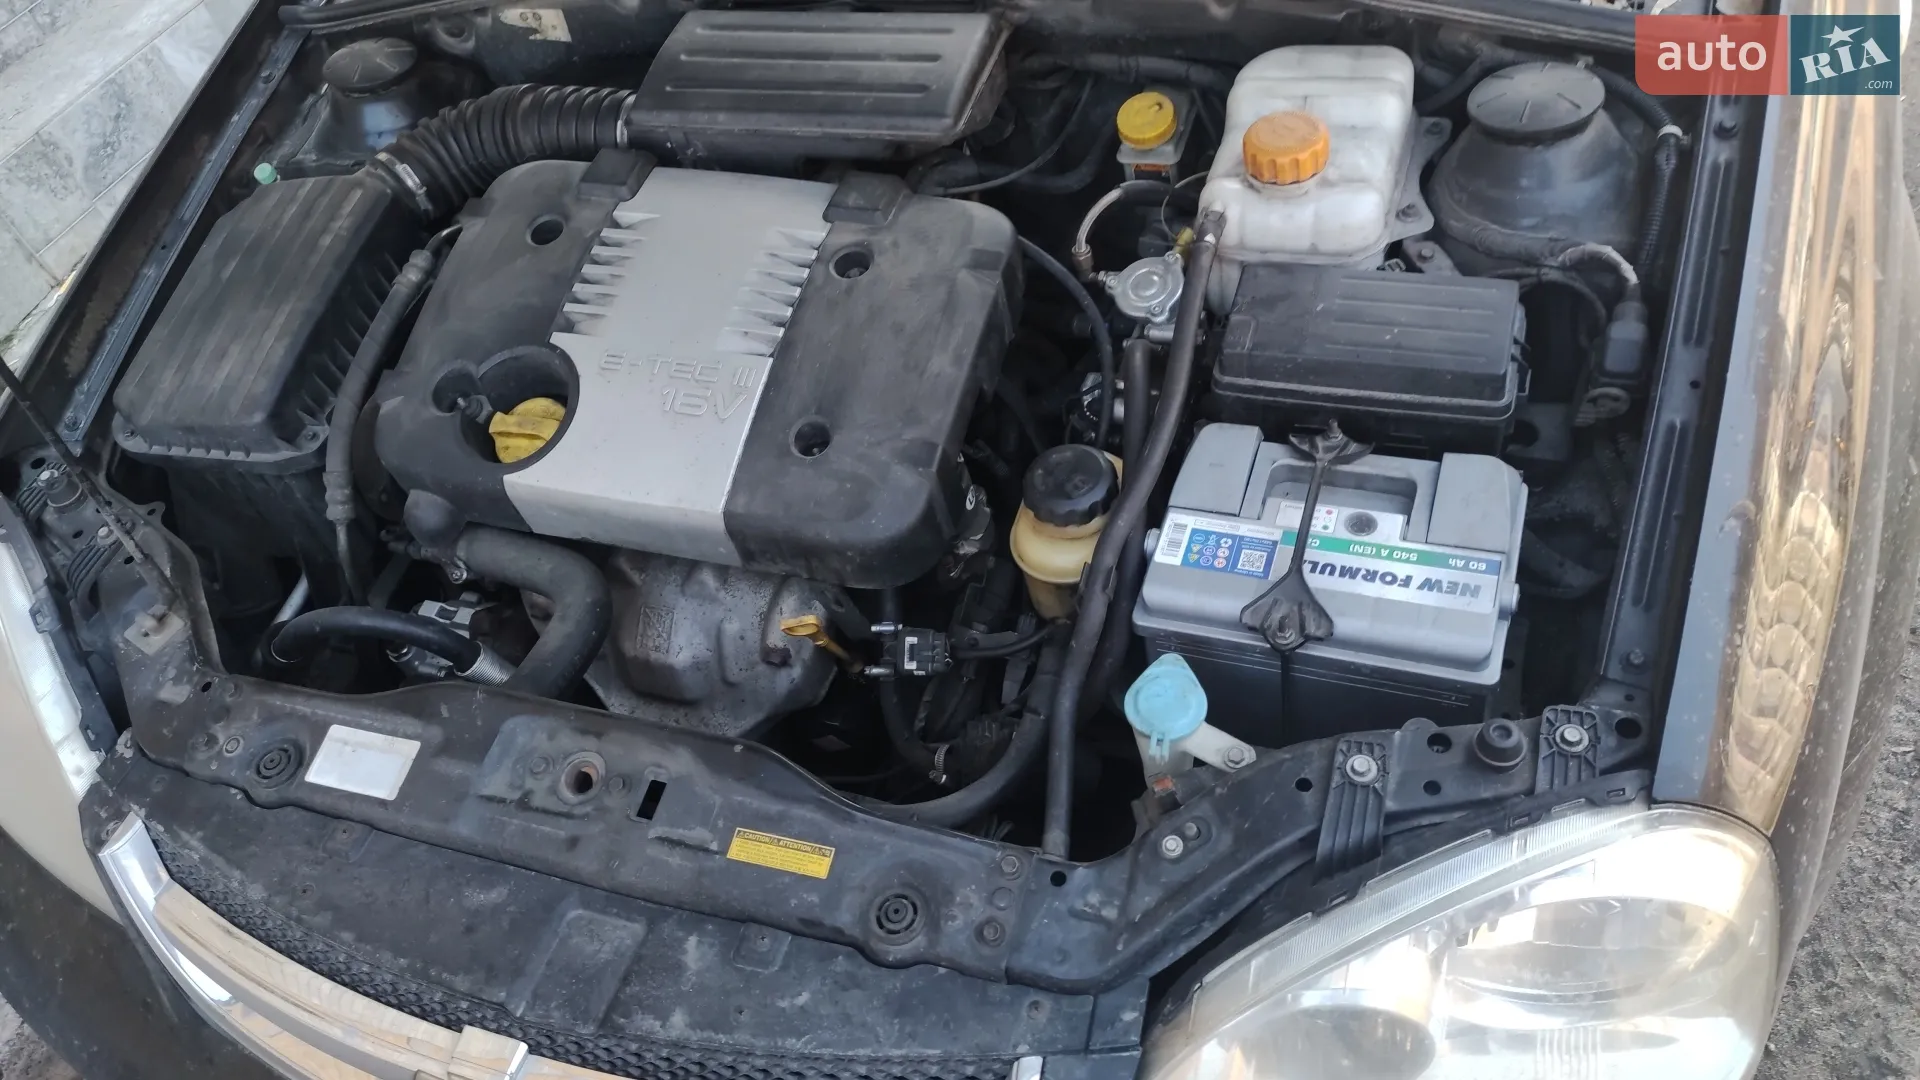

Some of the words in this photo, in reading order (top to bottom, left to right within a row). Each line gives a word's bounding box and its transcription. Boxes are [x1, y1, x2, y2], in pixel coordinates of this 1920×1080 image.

[599, 350, 723, 383] E-TEC
[661, 385, 748, 420] 16V
[1349, 543, 1378, 557] (EN)
[1380, 548, 1390, 558] A
[1393, 550, 1418, 562] 540
[1448, 557, 1467, 568] Ah
[1468, 560, 1487, 571] 60
[1417, 577, 1482, 598] NEW
